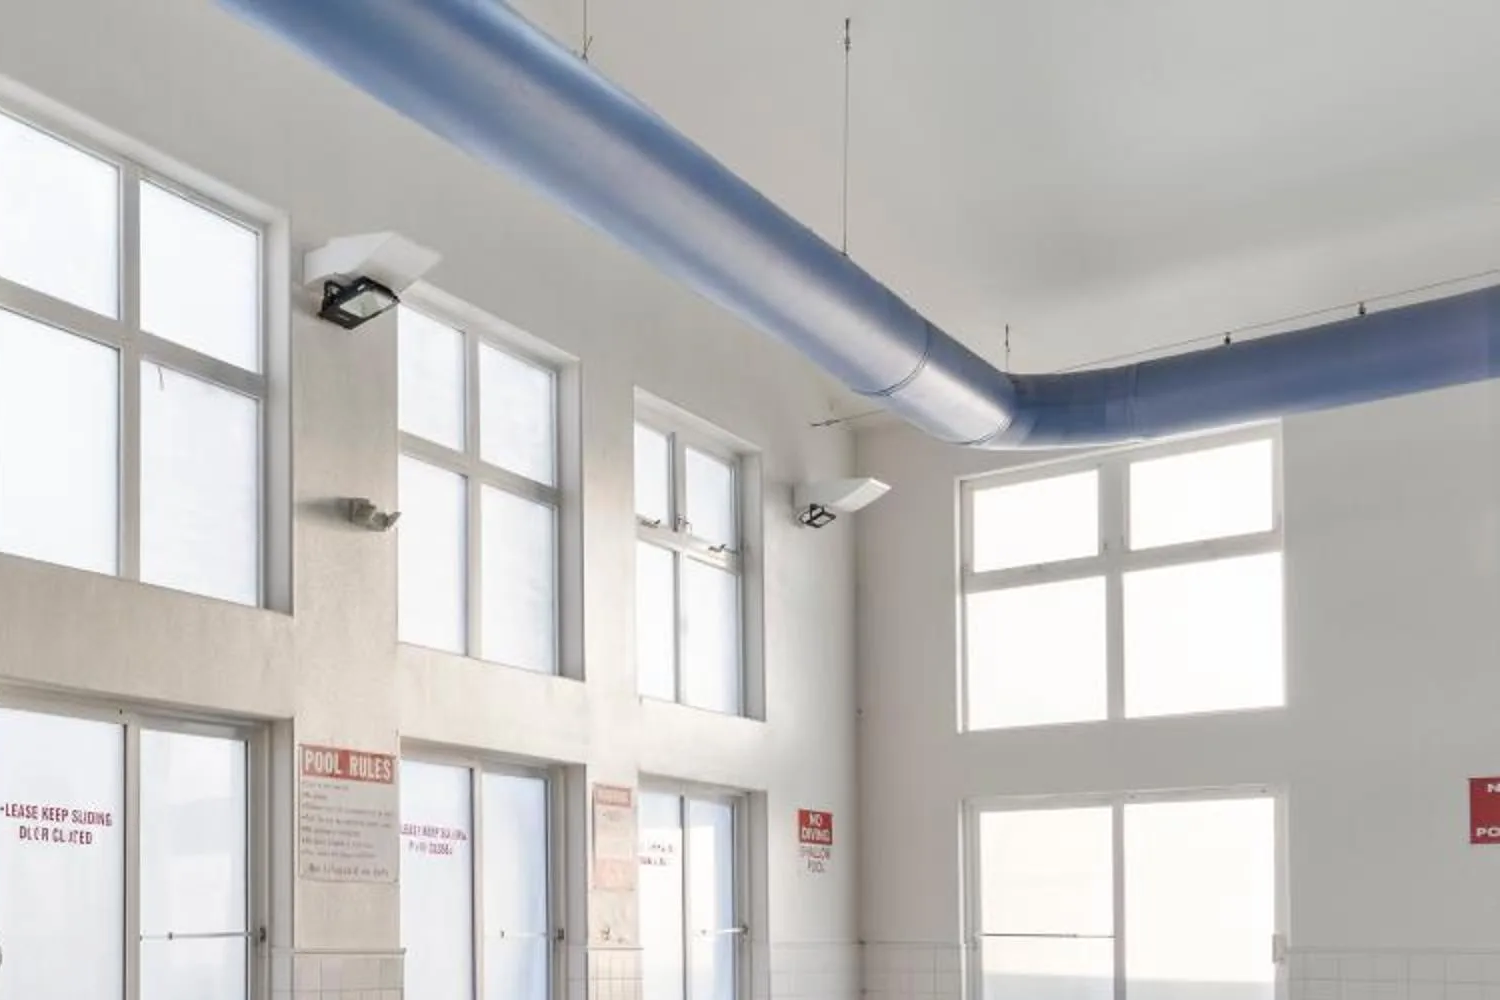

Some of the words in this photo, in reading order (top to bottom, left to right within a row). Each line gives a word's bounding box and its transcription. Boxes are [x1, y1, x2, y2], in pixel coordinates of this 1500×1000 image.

[305, 749, 342, 775] POOL
[349, 755, 392, 781] RULES
[1487, 783, 1500, 793] N
[0, 802, 38, 820] LEASE
[41, 806, 69, 823] KEEP
[71, 809, 113, 827] SLIDING
[809, 812, 823, 827] NO
[801, 827, 830, 841] DIVING
[1476, 827, 1500, 837] PO
